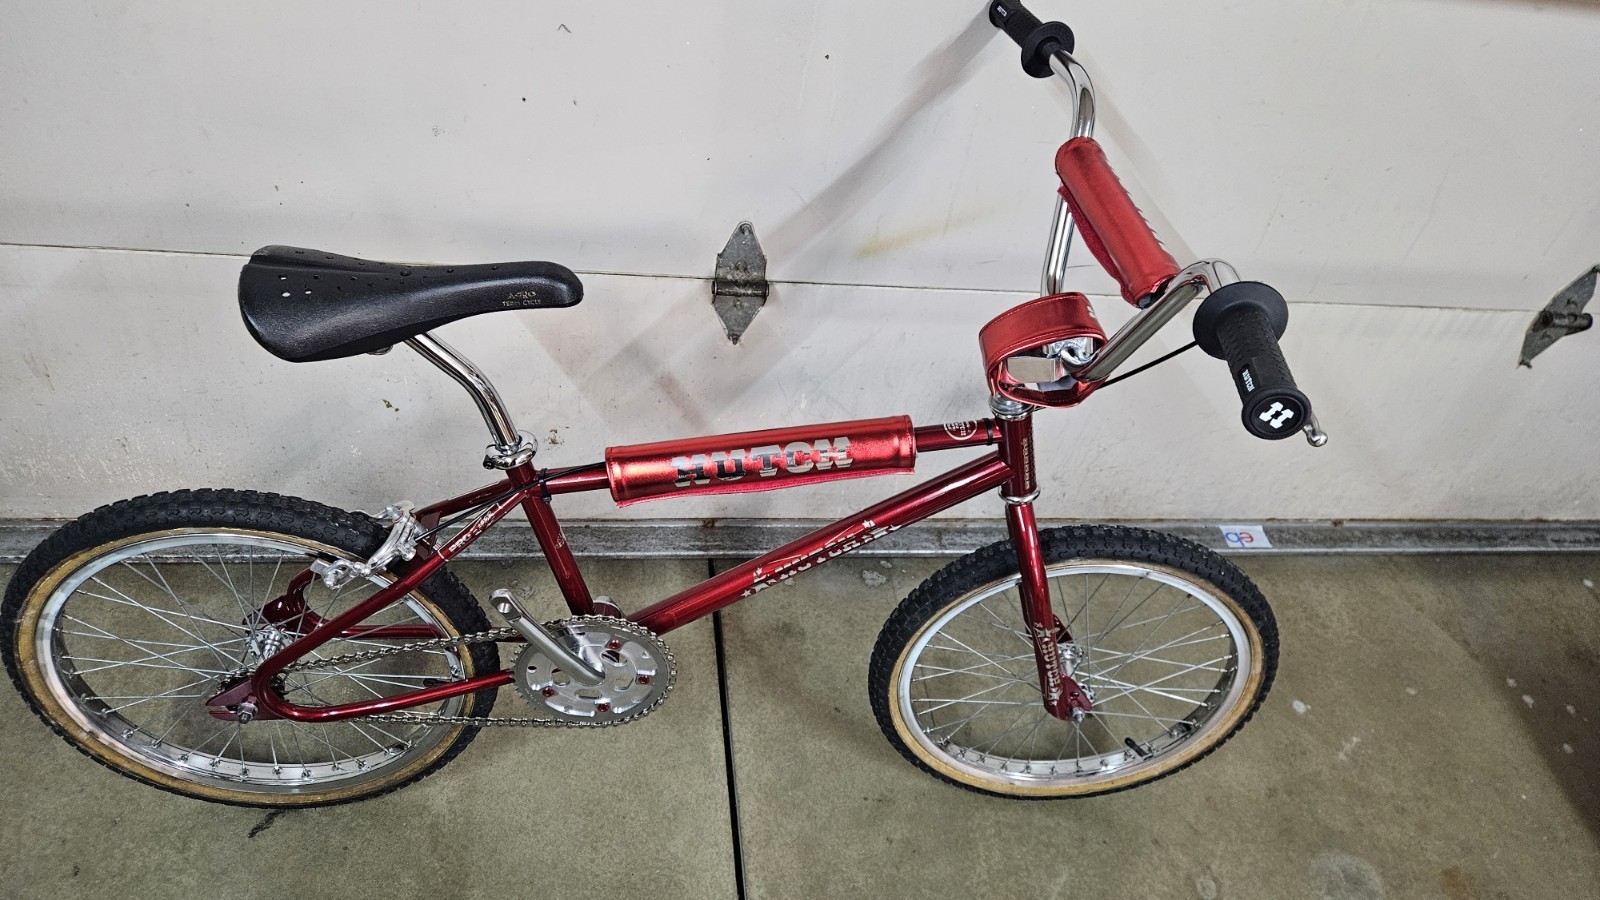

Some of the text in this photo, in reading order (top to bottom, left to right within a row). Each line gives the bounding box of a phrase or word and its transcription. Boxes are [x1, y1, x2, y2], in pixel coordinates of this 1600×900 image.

[1242, 369, 1255, 392] HUTCH
[671, 436, 853, 488] HUTCH
[1041, 641, 1061, 687] HUTCH
